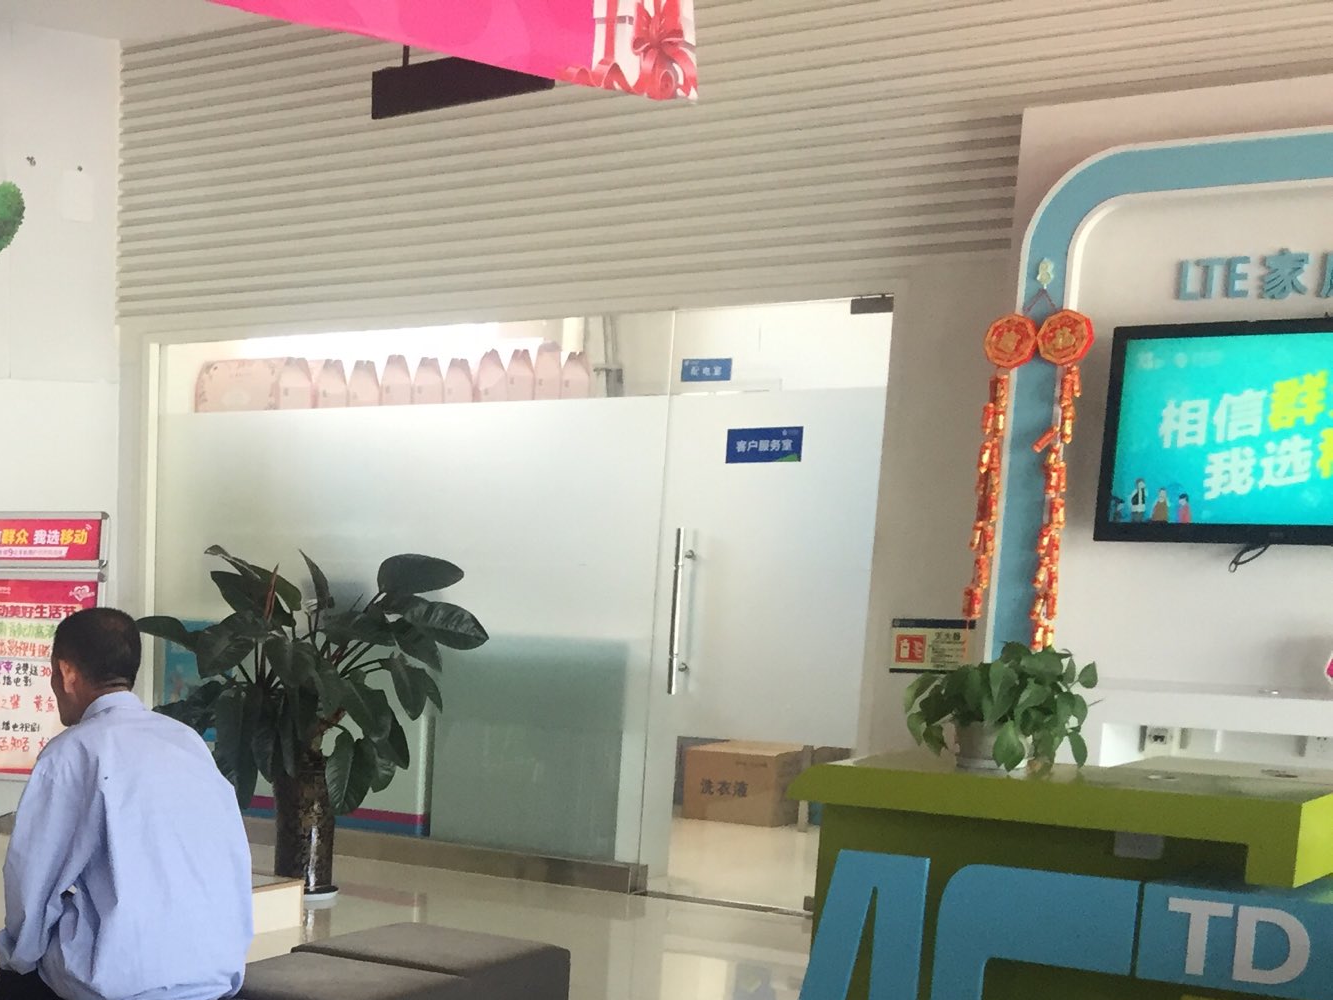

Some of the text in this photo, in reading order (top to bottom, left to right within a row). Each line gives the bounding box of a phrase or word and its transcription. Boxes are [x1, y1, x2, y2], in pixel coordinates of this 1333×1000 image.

[1159, 370, 1333, 449] 相信群
[735, 438, 794, 453] 客户服务室
[33, 528, 88, 545] 我选移动
[699, 778, 749, 799] 洗衣液
[1167, 897, 1311, 986] TD
